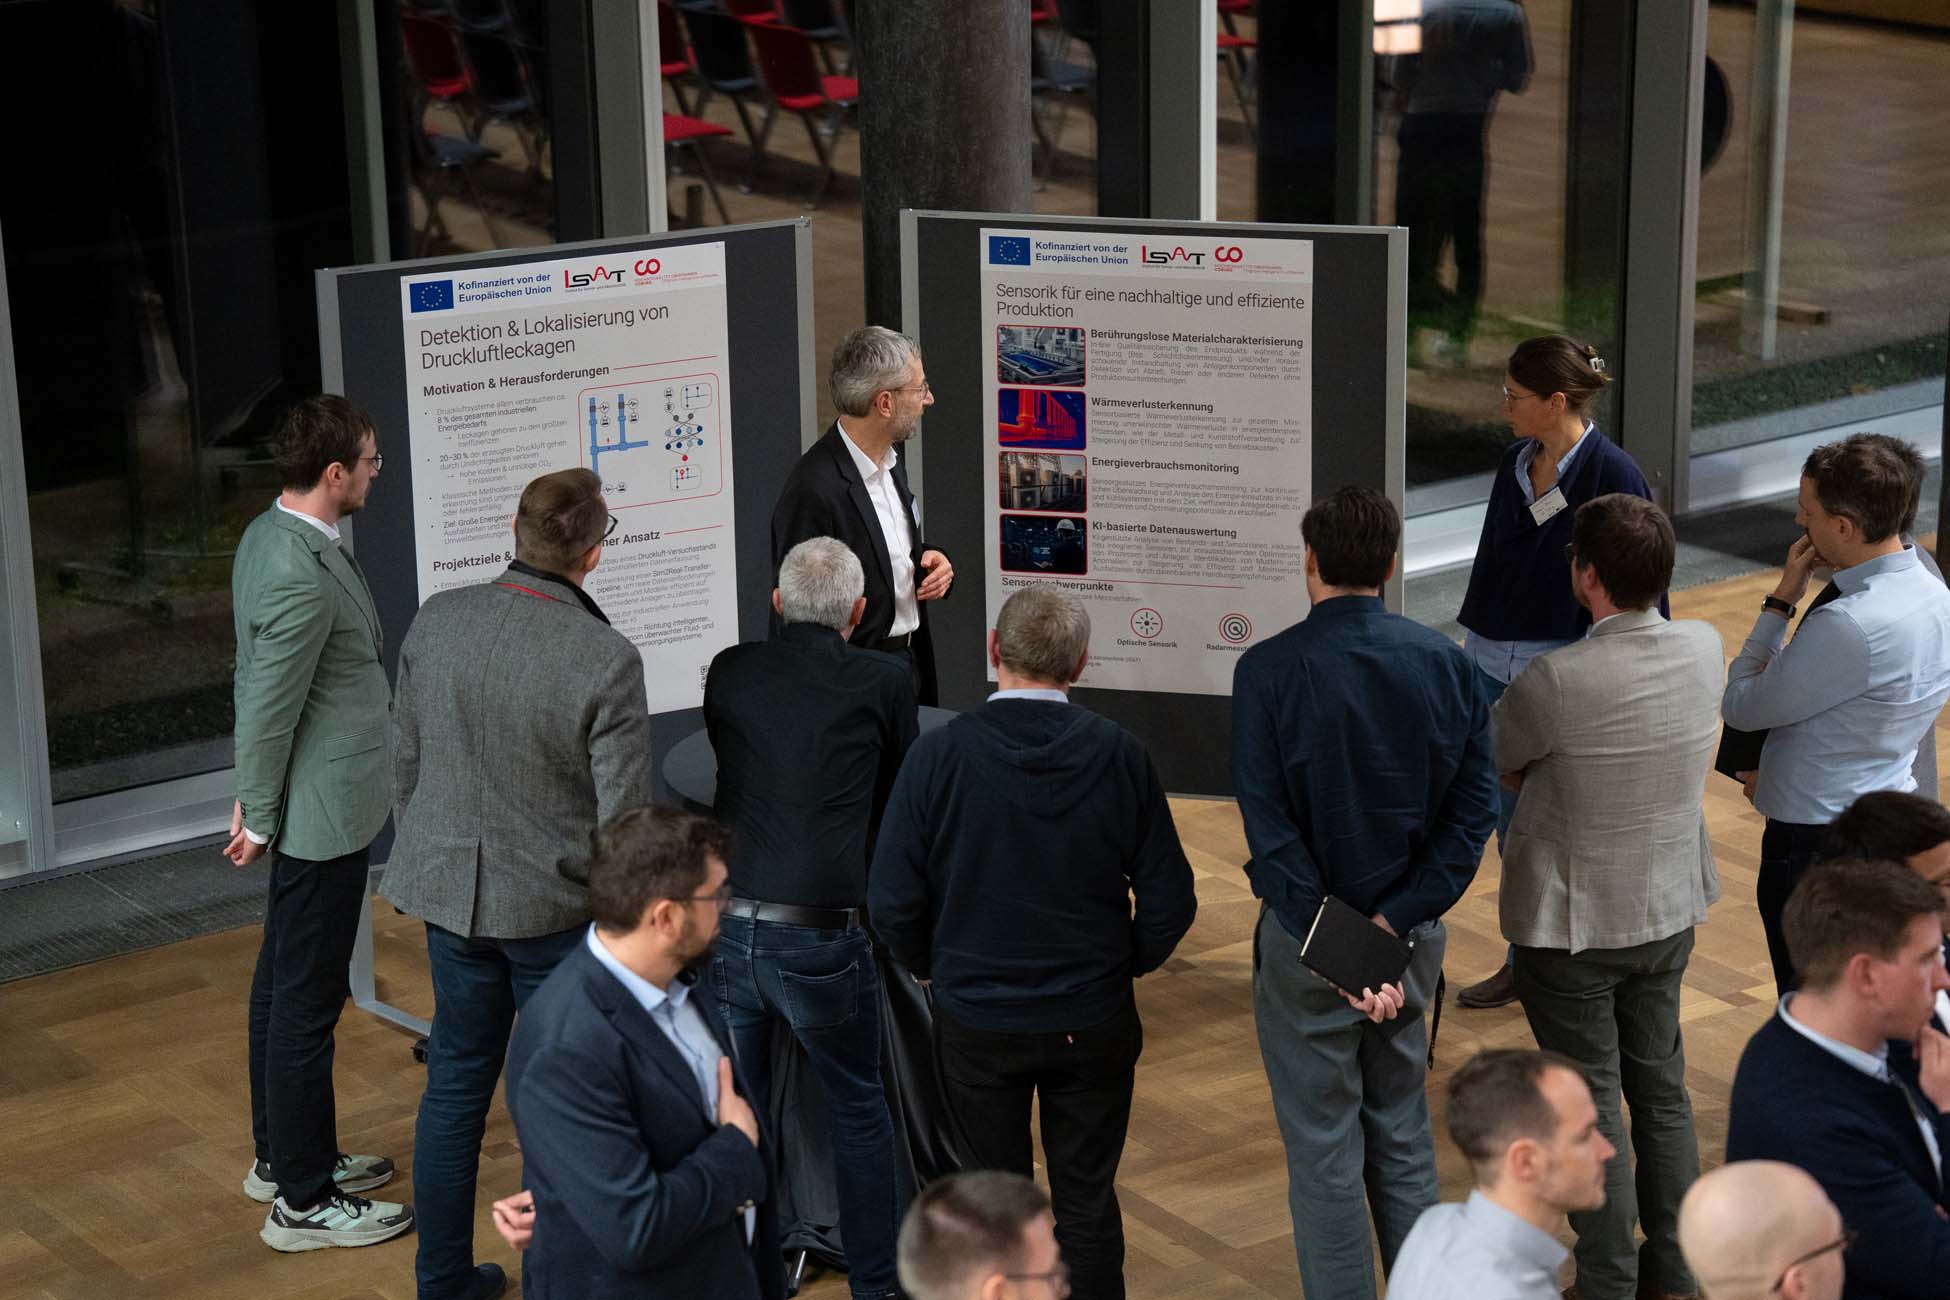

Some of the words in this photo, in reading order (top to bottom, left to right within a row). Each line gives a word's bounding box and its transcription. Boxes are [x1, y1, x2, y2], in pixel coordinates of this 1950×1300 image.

[1035, 241, 1090, 251] Kofinanziert
[1113, 244, 1128, 252] der
[1035, 253, 1097, 263] Europäischen
[1101, 255, 1128, 264] Union
[458, 277, 514, 289] Kofinanziert
[516, 276, 533, 284] von
[536, 273, 550, 281] der
[458, 289, 522, 302] Europäischen
[525, 285, 551, 294] Union
[996, 283, 1057, 298] Sensorik
[1062, 285, 1080, 299] für
[1085, 287, 1114, 301] eine
[1118, 289, 1201, 307] nachhaltige
[1206, 292, 1232, 306] und
[1237, 292, 1304, 309] effiziente
[996, 301, 1073, 317] Produktion
[420, 324, 501, 346] Detektion
[507, 320, 519, 336] &
[524, 310, 634, 334] Lokalisierung
[639, 305, 668, 320] von
[1090, 329, 1169, 342] Berührungslose
[1172, 332, 1303, 348] Materialcharakterisierung
[422, 339, 574, 369] Druckluftleckagen
[423, 381, 484, 396] Motivation
[488, 377, 495, 388] &
[499, 366, 609, 386] Herausforderungen
[1091, 397, 1213, 413] Wärmeverlusterkennung
[1092, 457, 1239, 474] Energieverbrauchsmonitoring
[622, 531, 660, 544] Ansatz
[1092, 521, 1146, 532] KI-basierte
[1149, 525, 1236, 538] Datenauswertung
[433, 553, 500, 571] Projektziele
[504, 550, 511, 561] &
[1117, 638, 1146, 646] Optische
